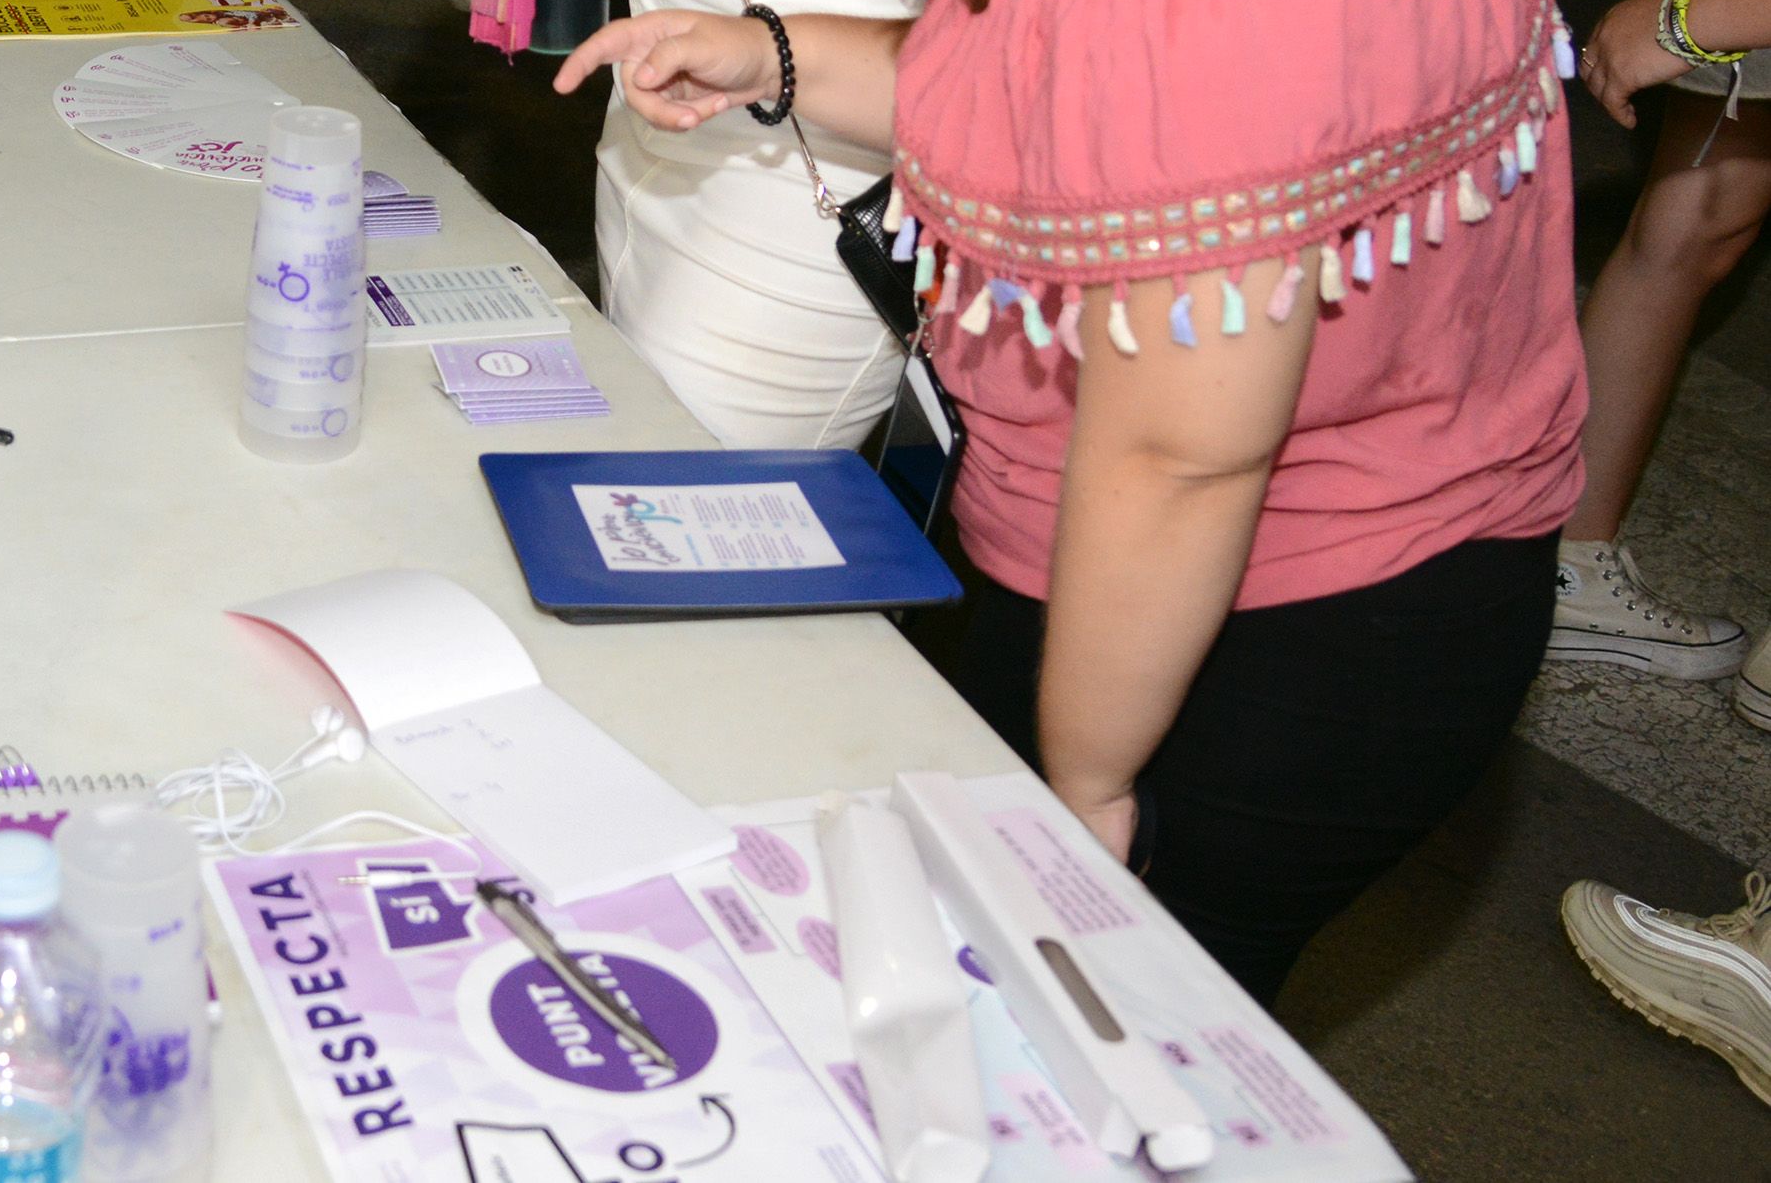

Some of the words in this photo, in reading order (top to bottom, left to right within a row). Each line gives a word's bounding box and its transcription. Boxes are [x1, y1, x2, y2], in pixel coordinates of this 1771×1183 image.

[21, 5, 53, 34] LLIBERTAT
[248, 872, 414, 1138] RESPECTA
[526, 980, 606, 1068] PUNT
